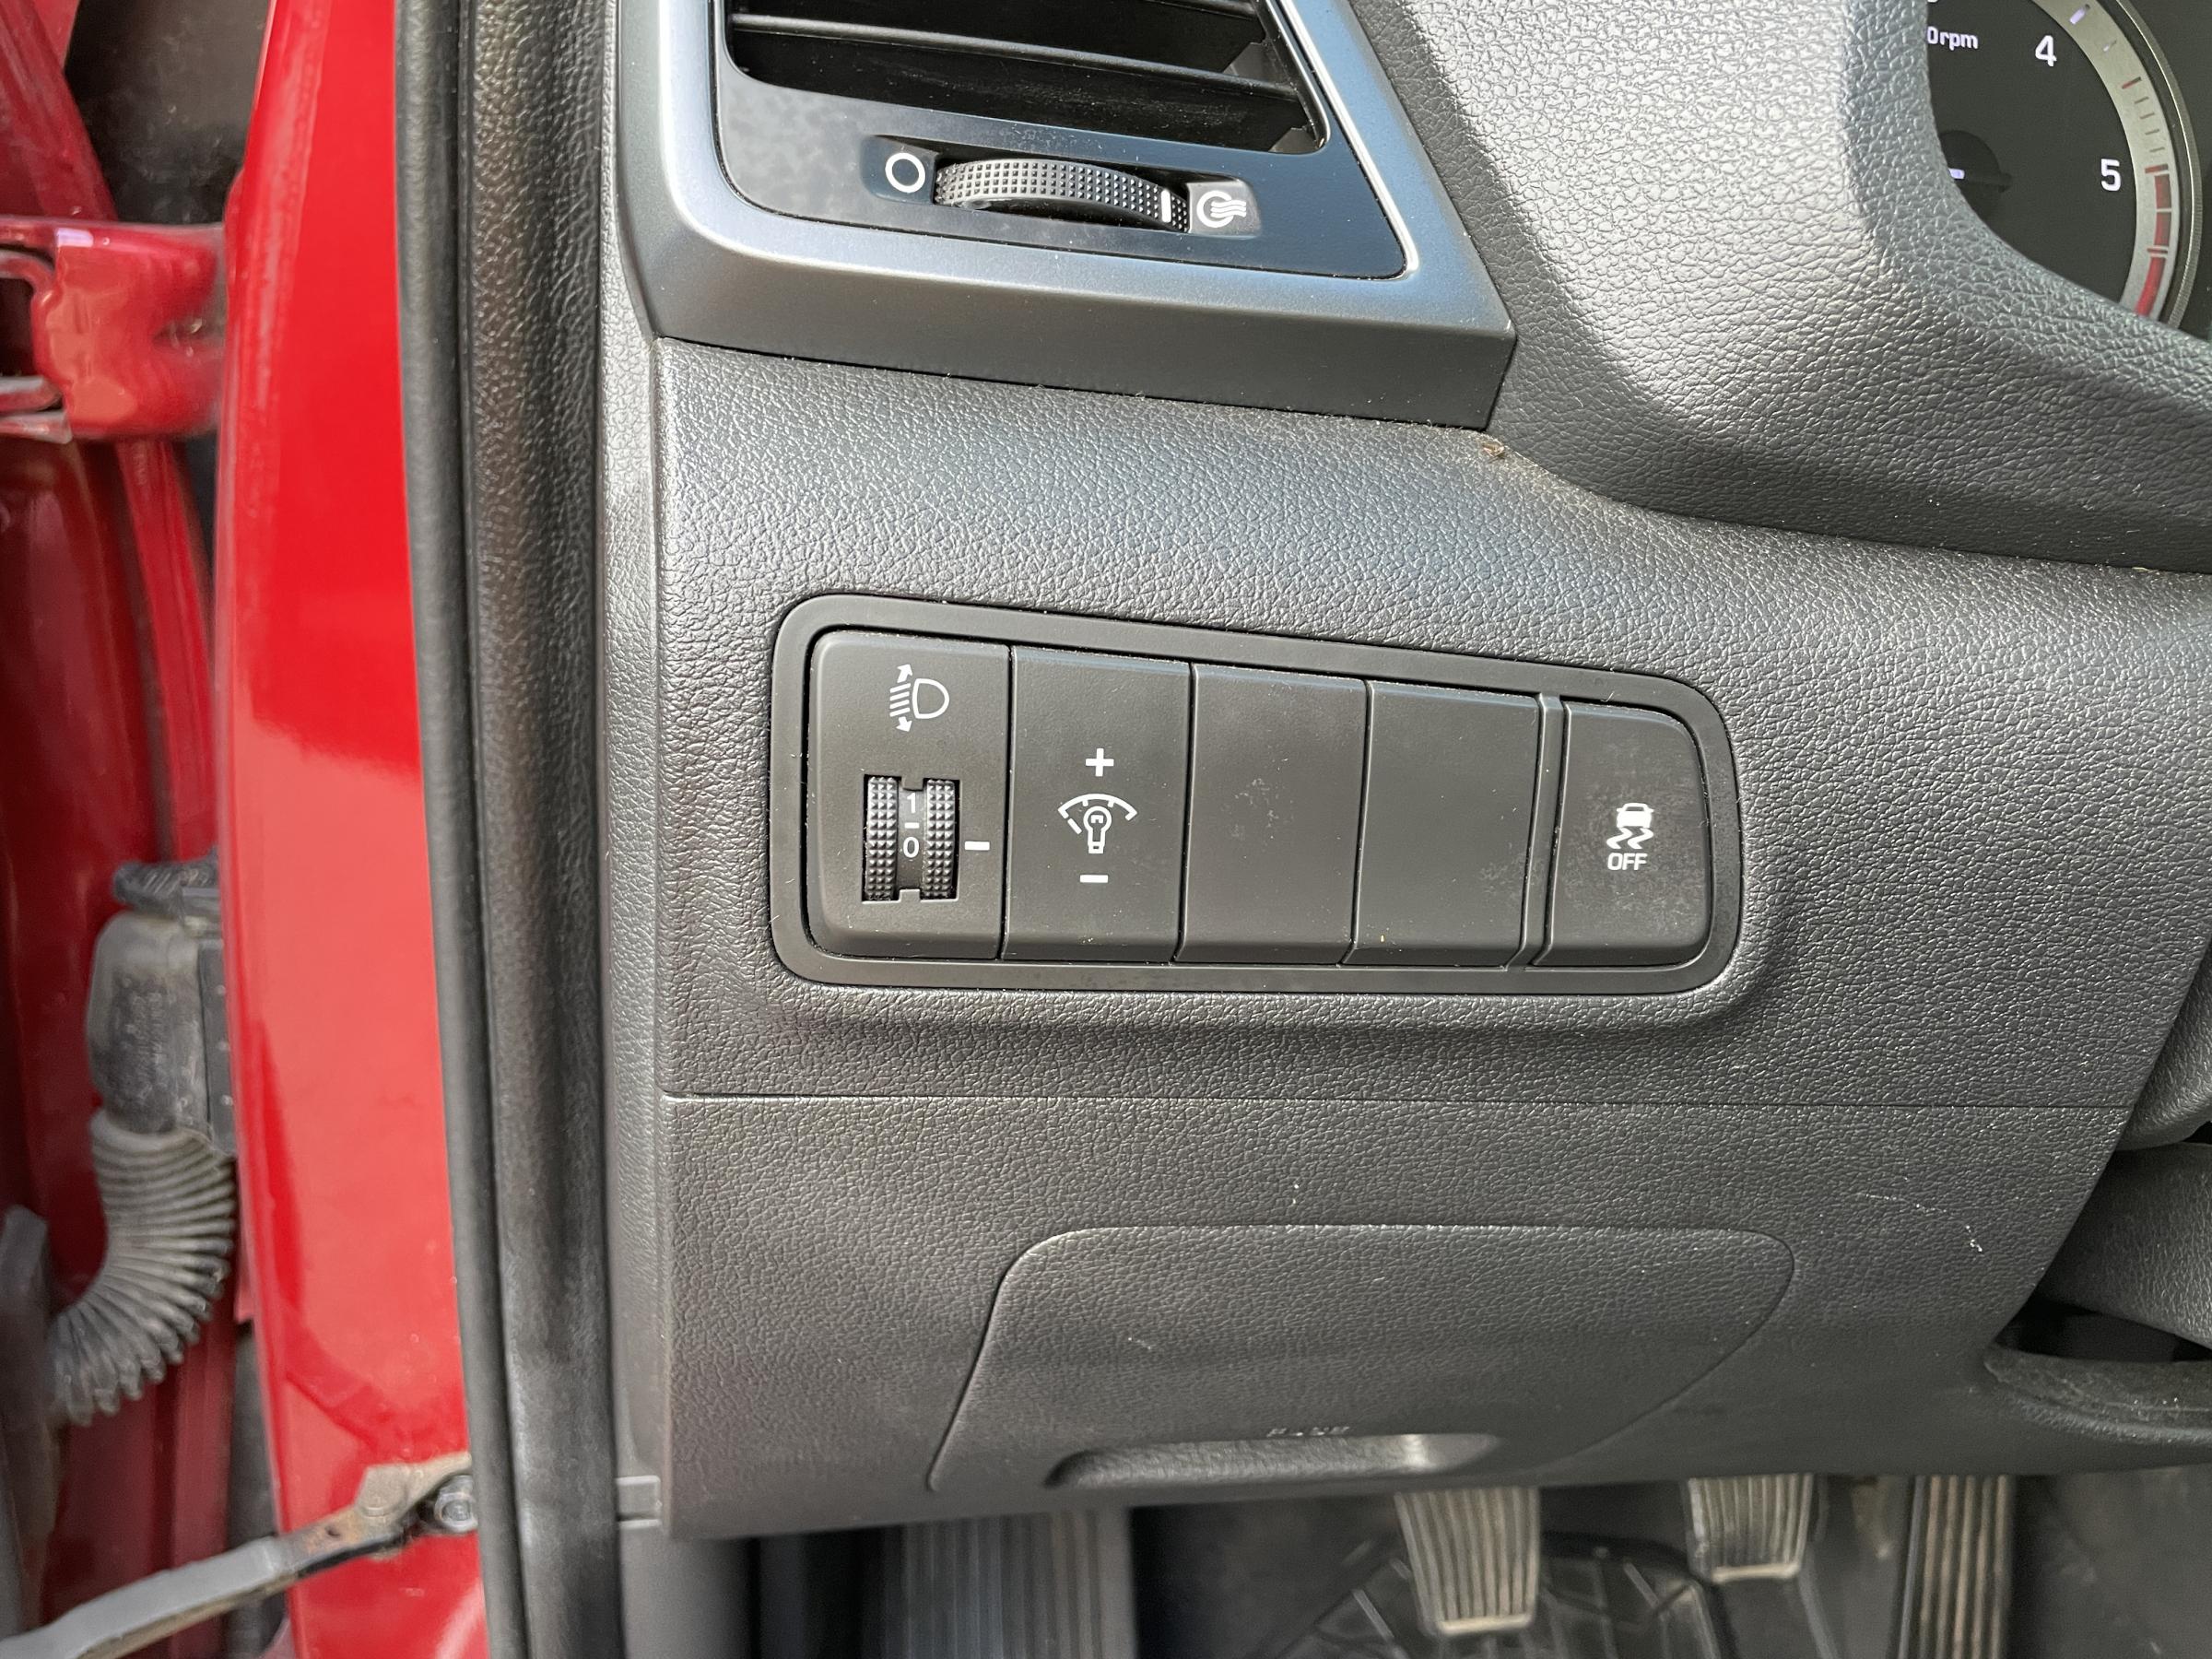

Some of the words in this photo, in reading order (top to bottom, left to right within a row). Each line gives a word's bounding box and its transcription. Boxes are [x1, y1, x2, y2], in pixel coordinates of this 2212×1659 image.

[2034, 35, 2057, 66] 4
[2100, 159, 2121, 192] 5
[906, 792, 916, 814] 1
[902, 835, 920, 858] 0
[1606, 852, 1648, 871] OFF
